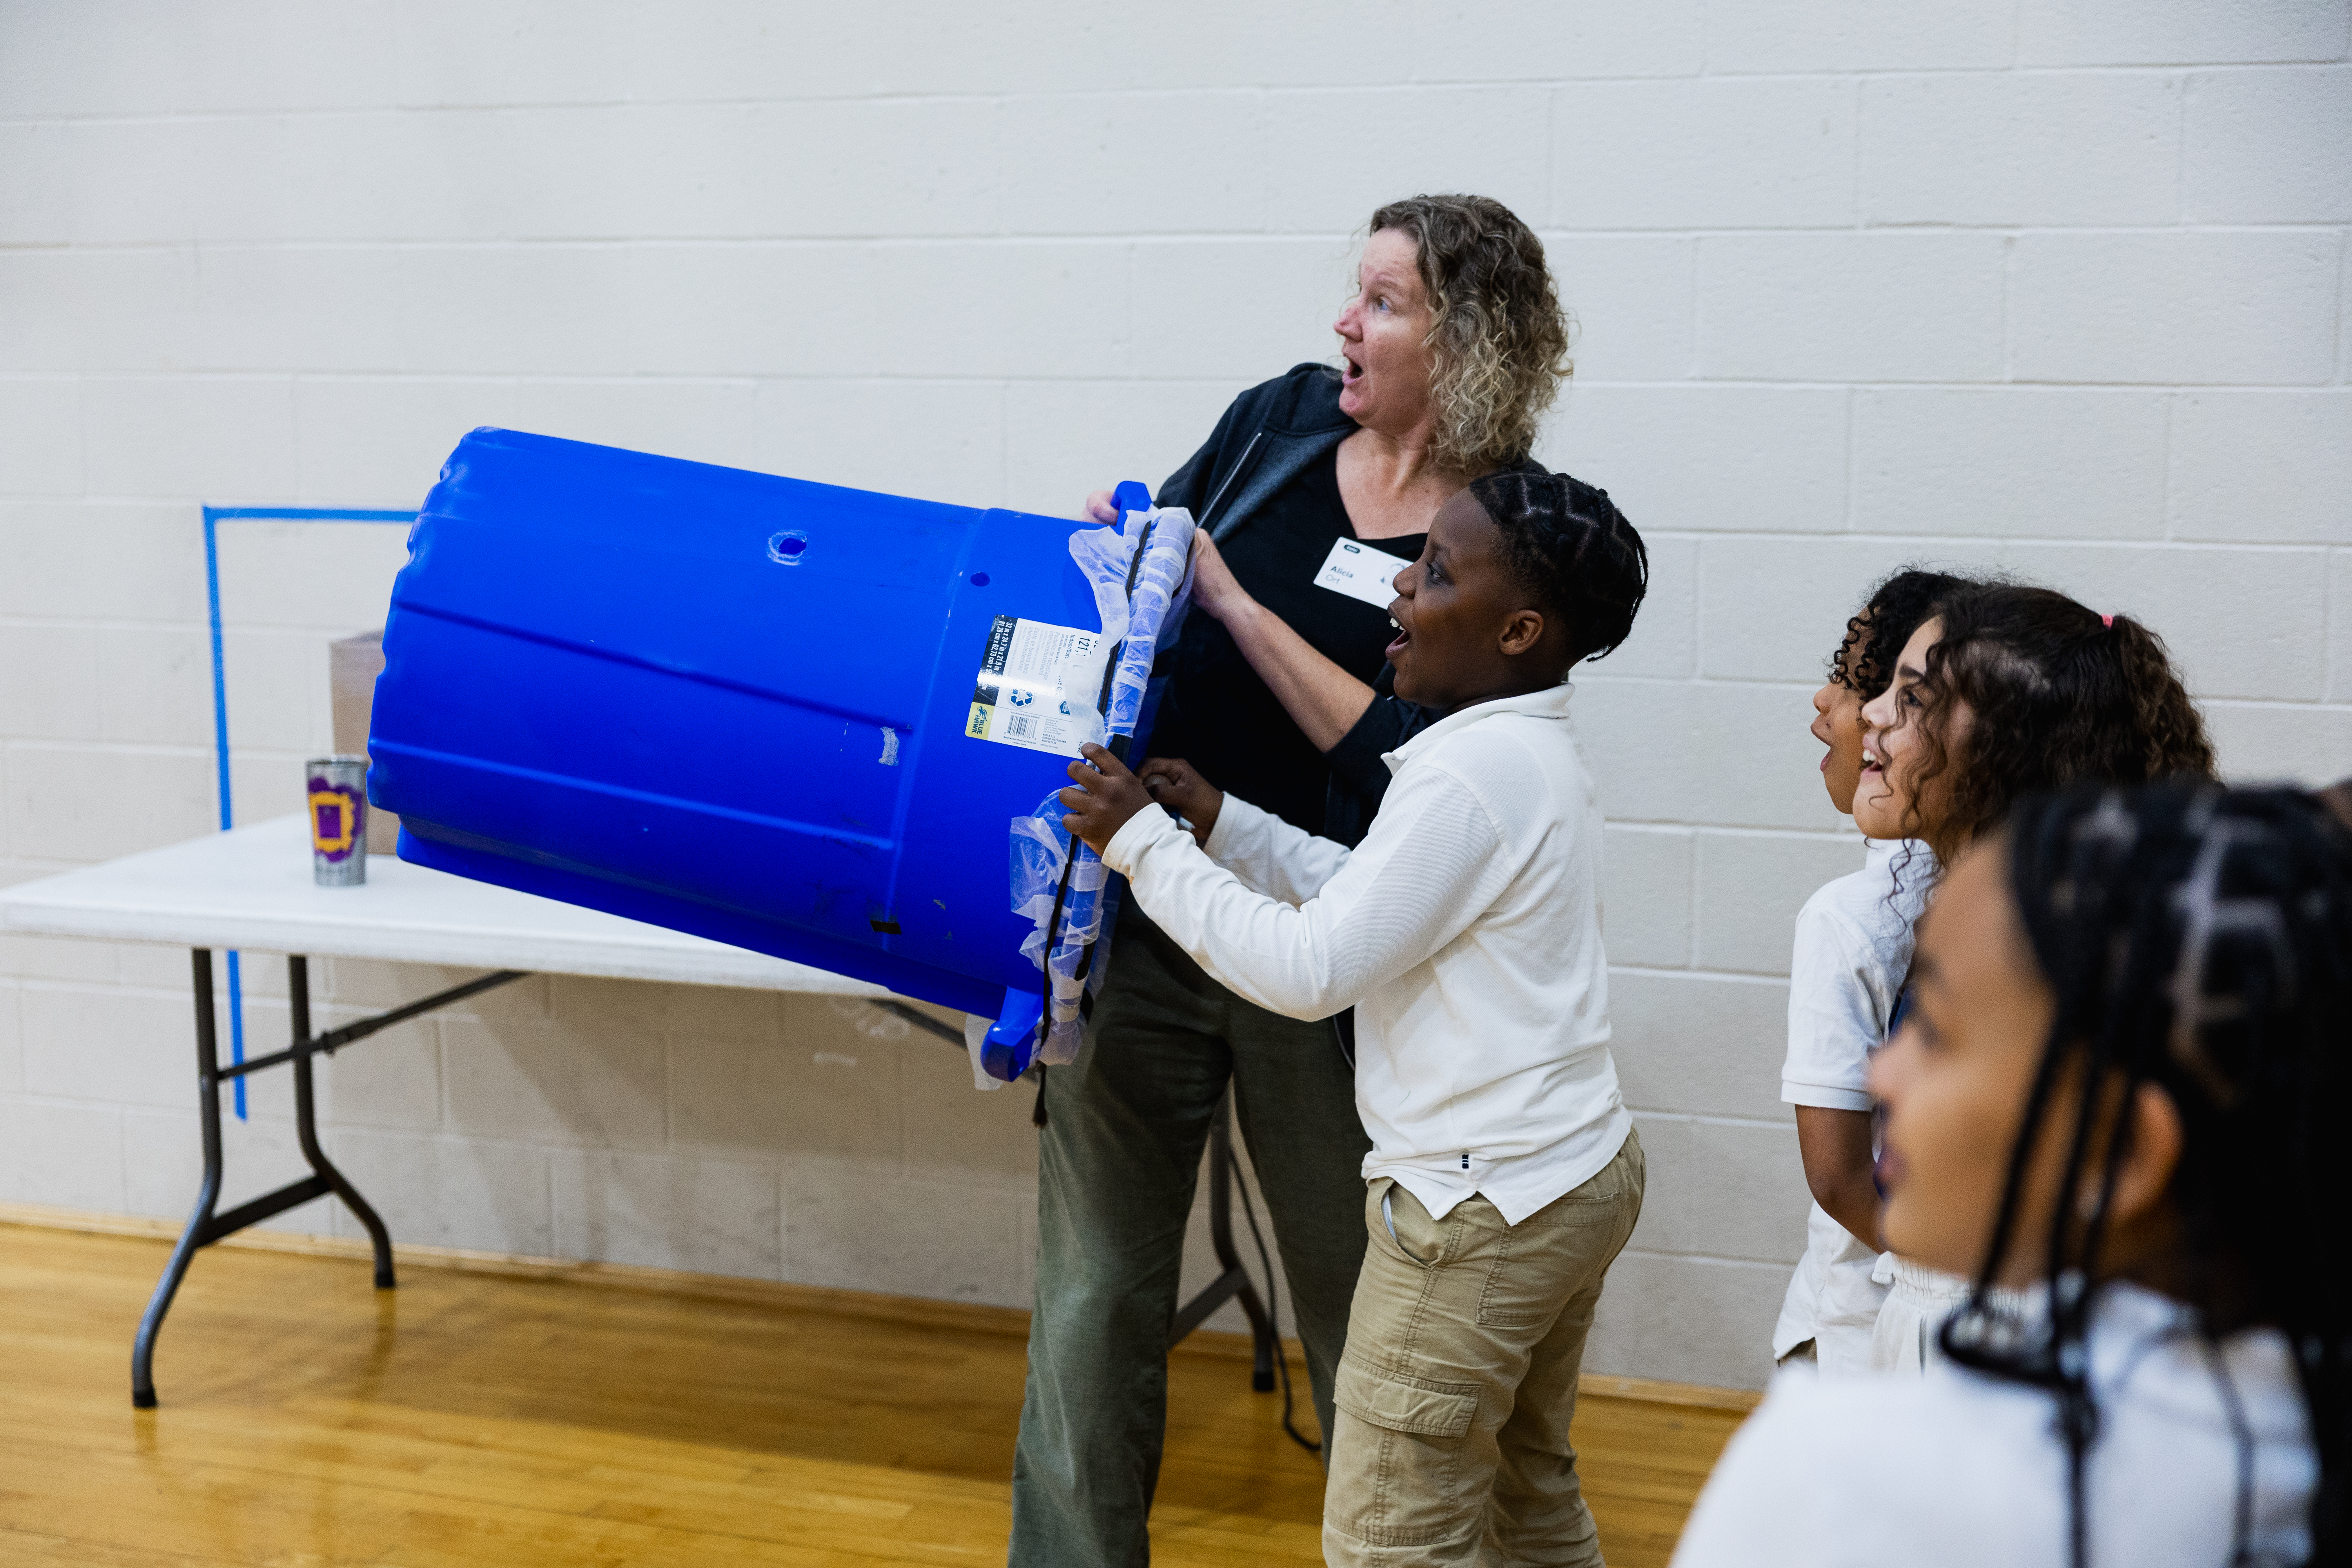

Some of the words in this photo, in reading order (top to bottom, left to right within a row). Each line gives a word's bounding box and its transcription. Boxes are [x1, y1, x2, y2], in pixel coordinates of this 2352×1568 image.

[1326, 574, 1340, 584] Ort
[1330, 566, 1354, 579] Alicia
[996, 621, 1005, 633] 81,28
[1051, 632, 1060, 650] Poubelle
[990, 644, 999, 657] 62,73
[1018, 627, 1033, 671] interiores/exteriores
[1026, 647, 1034, 662] basura
[1039, 631, 1054, 676] intérieure/extérieure
[995, 655, 1004, 666] 21.9
[1043, 658, 1053, 680] recyclage
